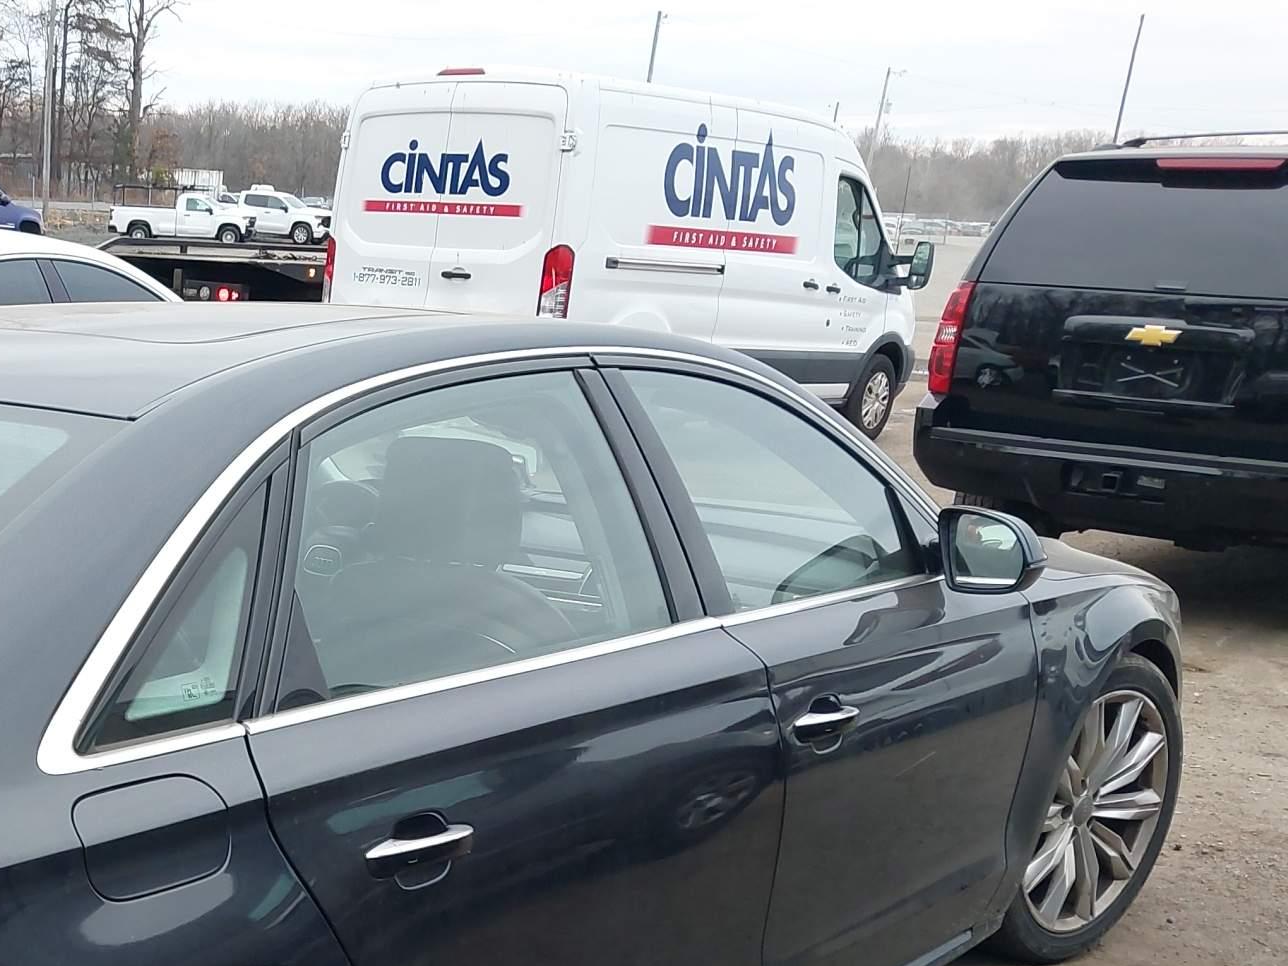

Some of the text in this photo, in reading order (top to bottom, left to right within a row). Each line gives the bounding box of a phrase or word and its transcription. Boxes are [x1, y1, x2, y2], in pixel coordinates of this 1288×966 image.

[384, 202, 495, 215] FIRST AID & SAFETY
[673, 231, 777, 249] FIRST AID & SAFETY
